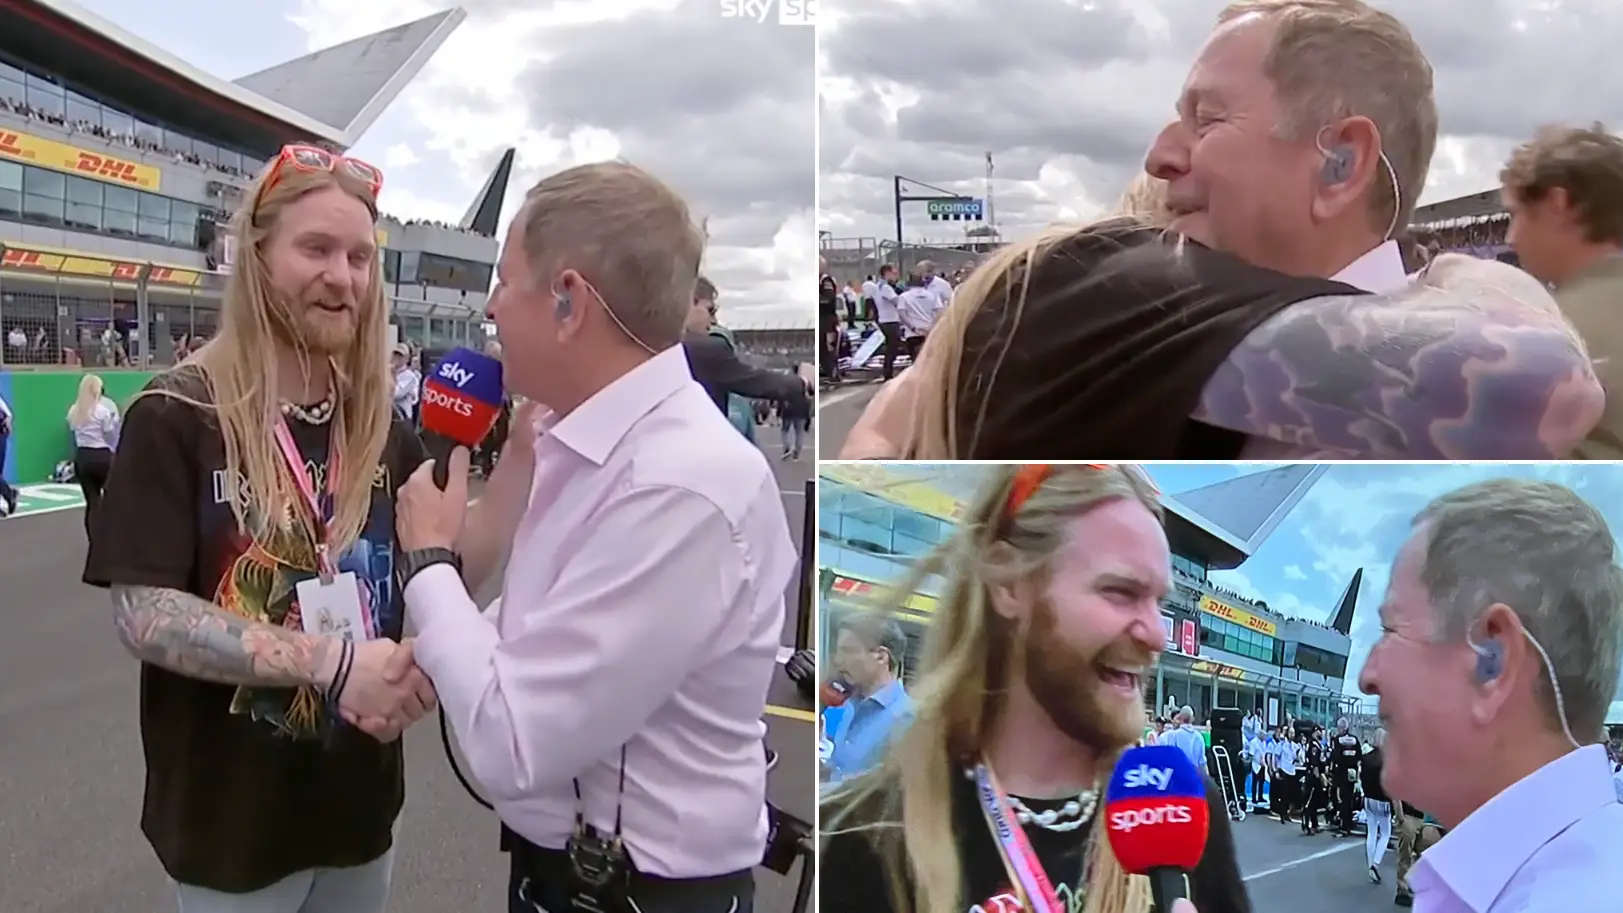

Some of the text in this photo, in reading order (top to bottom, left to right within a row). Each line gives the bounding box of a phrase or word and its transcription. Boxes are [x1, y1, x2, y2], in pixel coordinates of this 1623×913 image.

[0, 132, 21, 155] L
[77, 152, 137, 181] DHL
[930, 203, 979, 212] aramco
[439, 362, 475, 387] sky
[422, 388, 473, 417] sports
[1208, 600, 1233, 618] DHL
[1249, 616, 1269, 632] DHL
[1123, 764, 1174, 790] sky
[1110, 804, 1192, 832] sports
